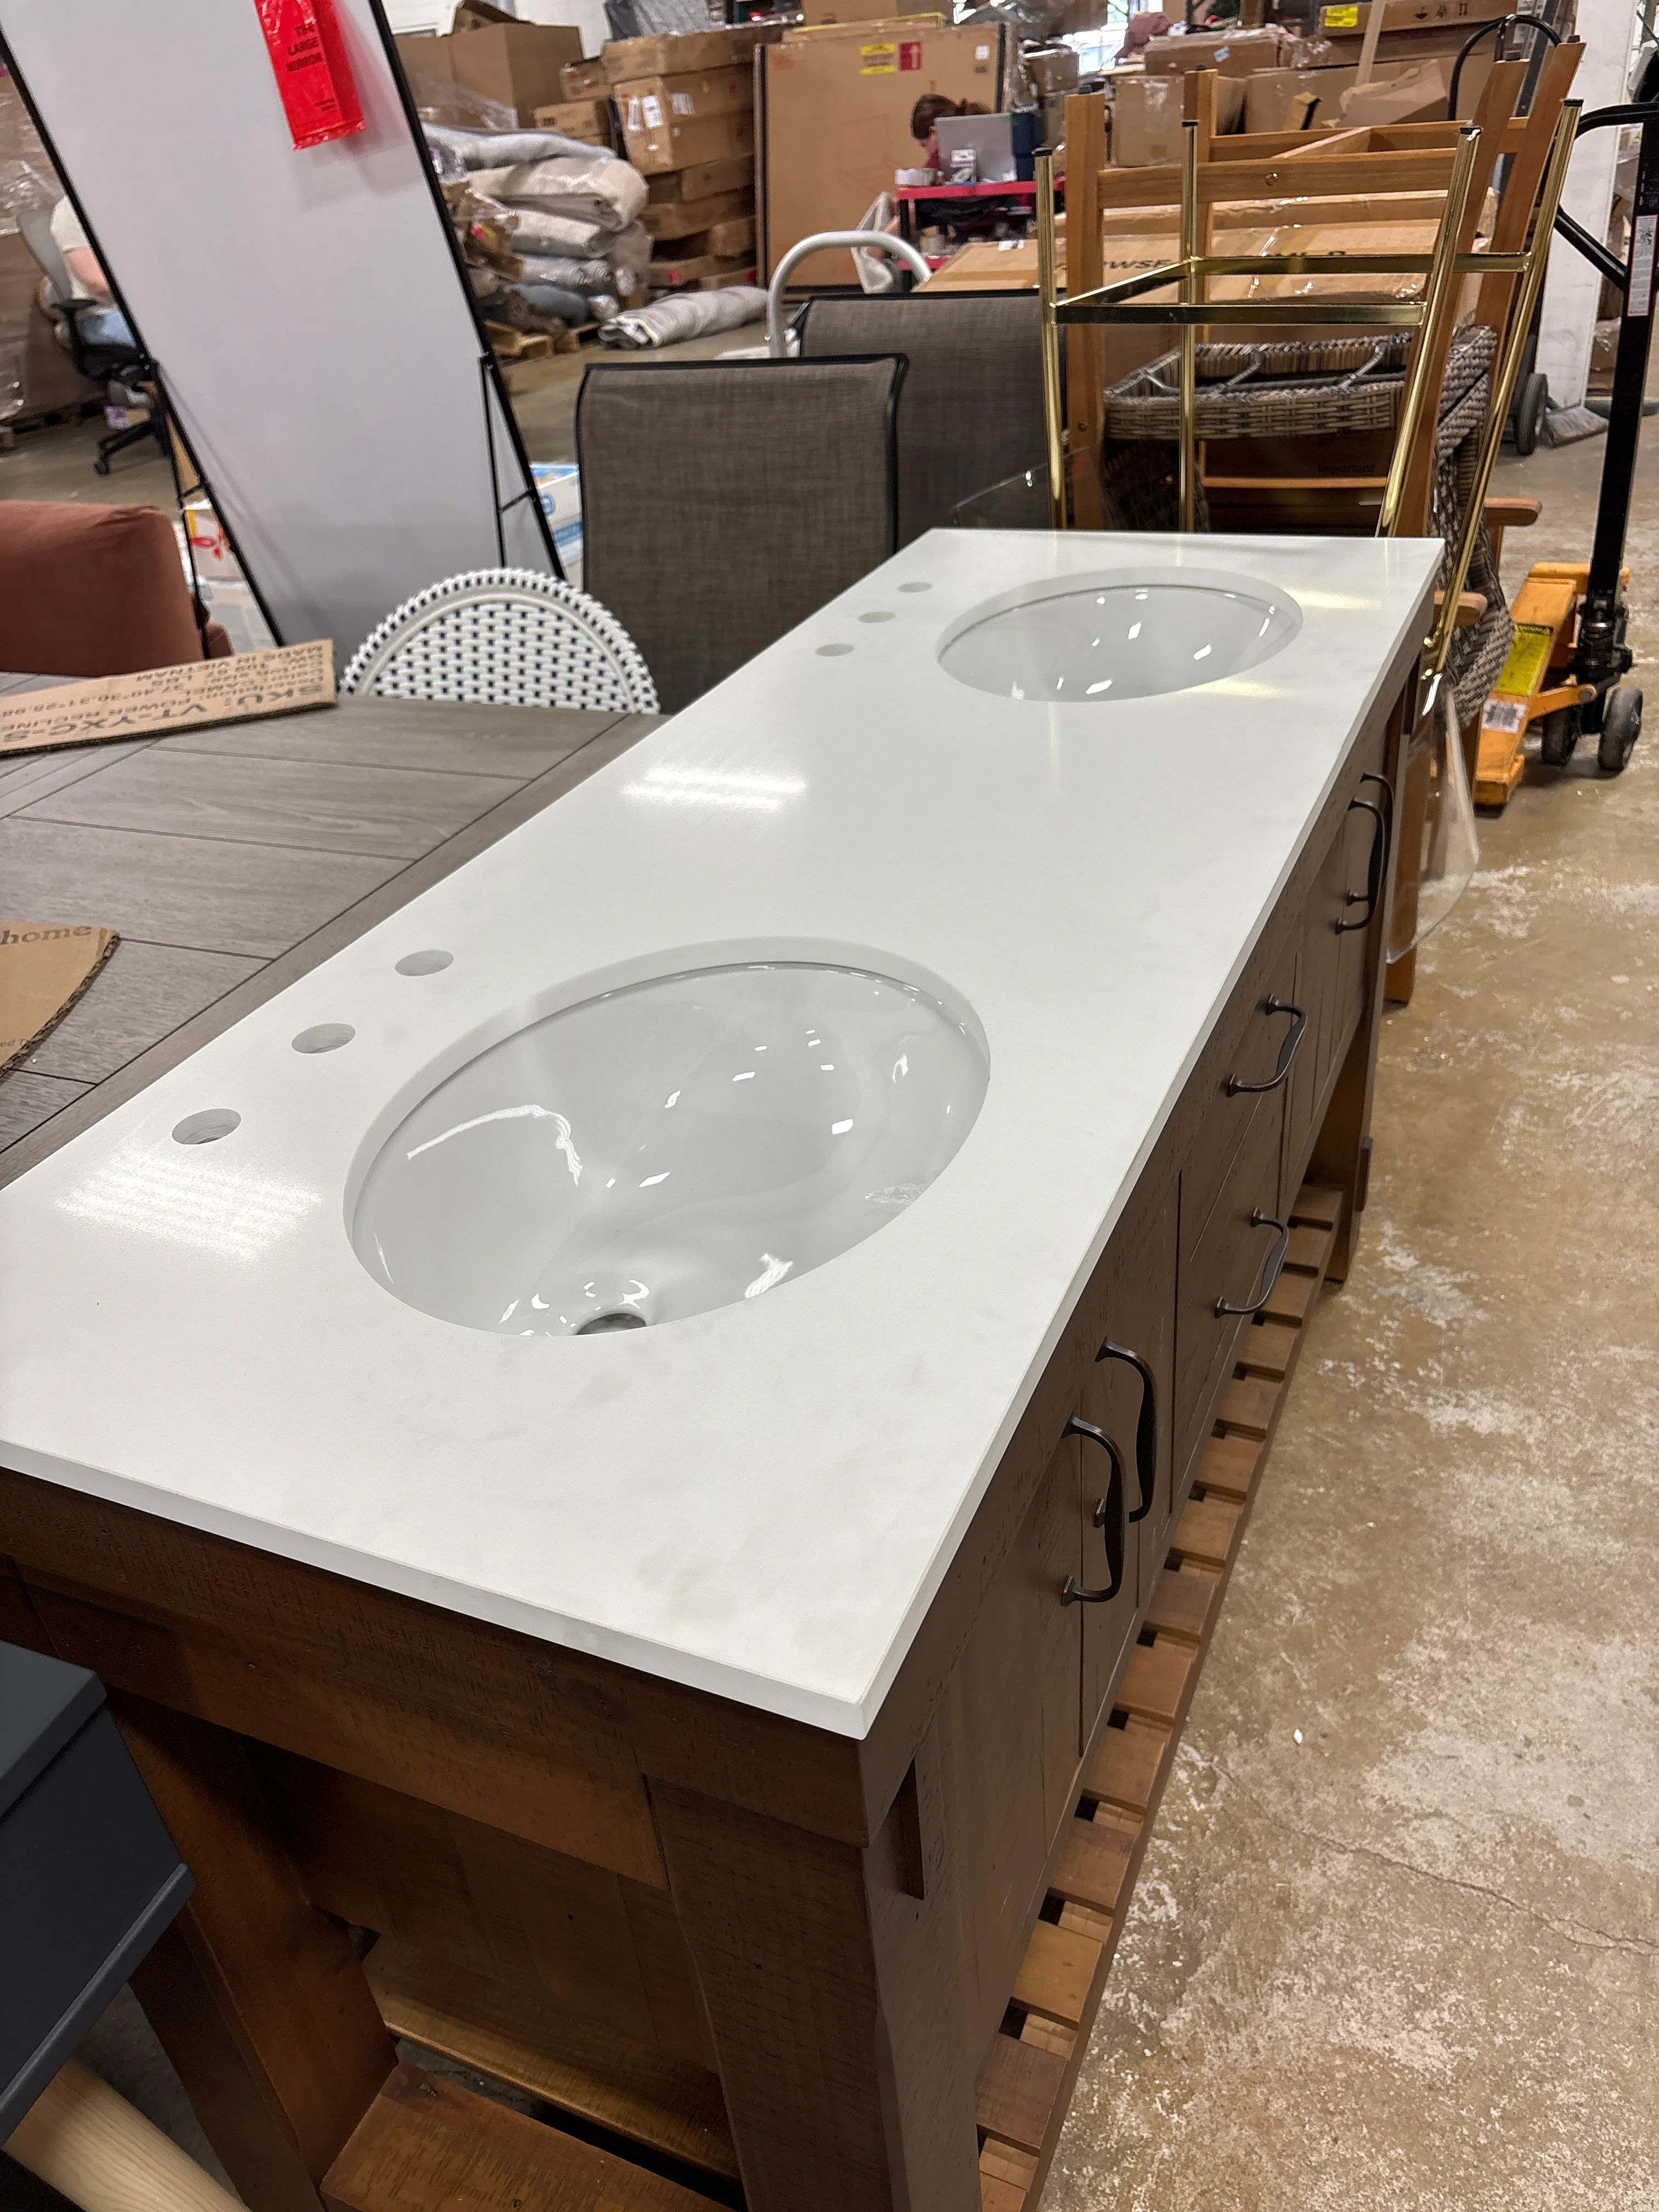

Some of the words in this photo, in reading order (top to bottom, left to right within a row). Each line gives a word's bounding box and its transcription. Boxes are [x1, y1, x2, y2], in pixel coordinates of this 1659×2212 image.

[236, 655, 256, 665] IN
[263, 644, 323, 661] MADE
[137, 661, 230, 682] VIETNAM
[179, 679, 255, 696] CAMEL
[223, 685, 322, 707] SKU:
[109, 698, 191, 716] POWER
